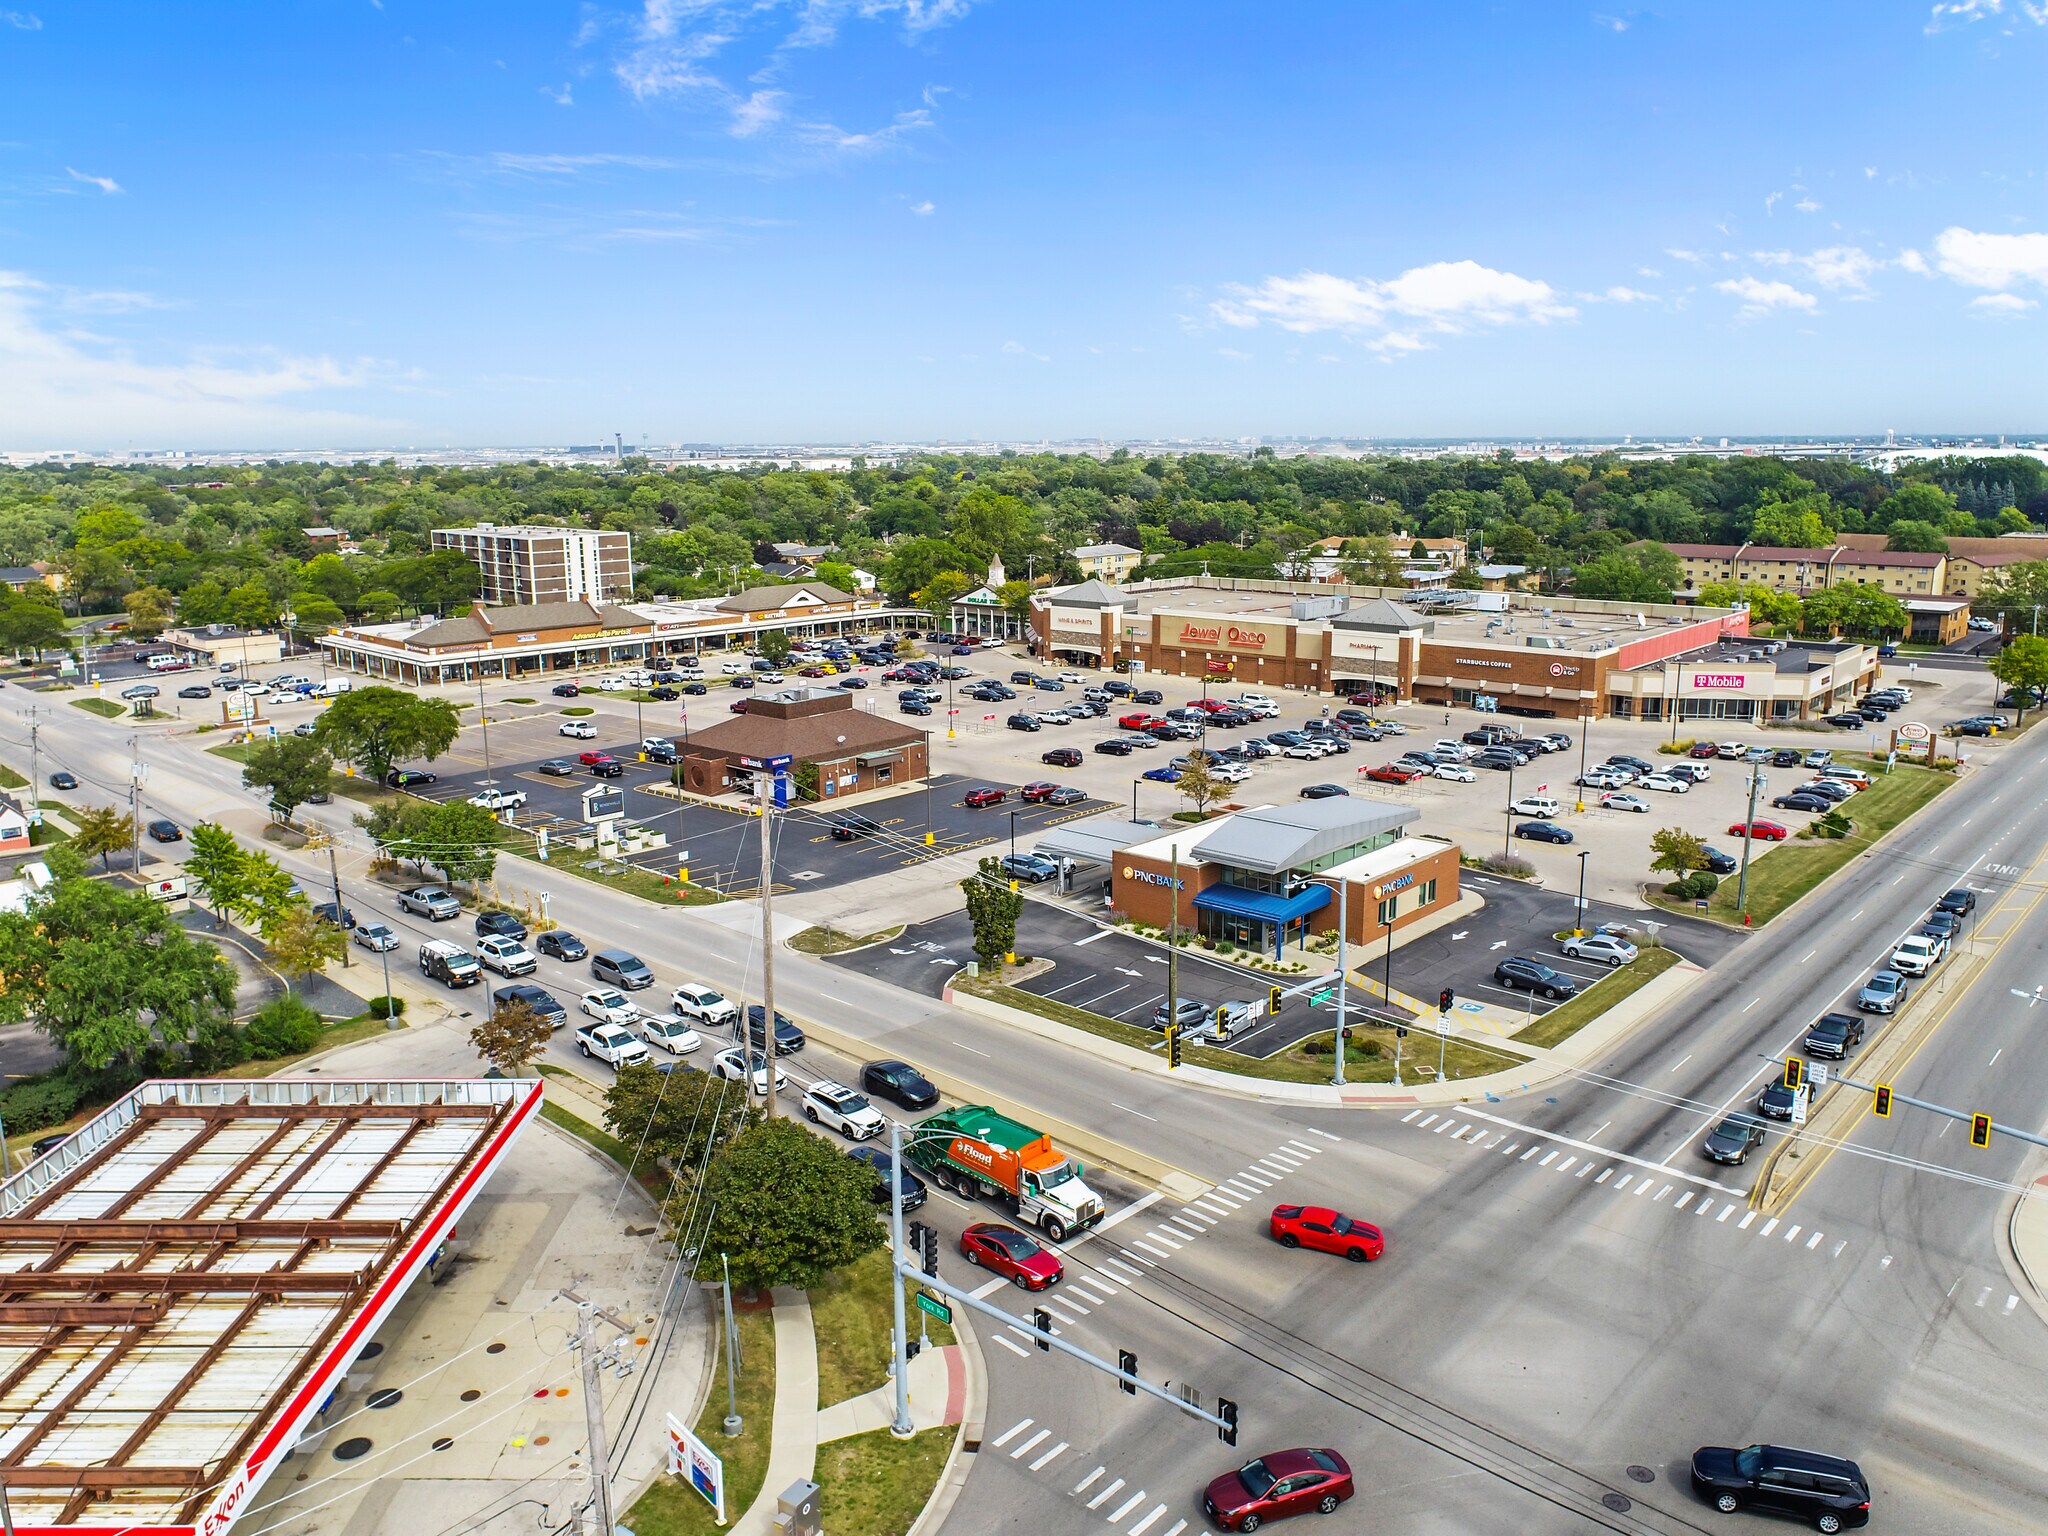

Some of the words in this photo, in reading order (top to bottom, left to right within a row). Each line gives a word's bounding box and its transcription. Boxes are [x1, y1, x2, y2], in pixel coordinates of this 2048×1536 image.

[571, 632, 596, 640] Advance
[596, 629, 611, 638] Auto
[611, 628, 628, 637] Parts
[1180, 624, 1222, 639] Jewel
[1228, 627, 1267, 643] Osco
[1456, 658, 1490, 666] STARBUCKS
[1707, 676, 1743, 687] Mobile
[963, 1143, 993, 1164] Flood
[203, 1481, 245, 1536] Exxon
